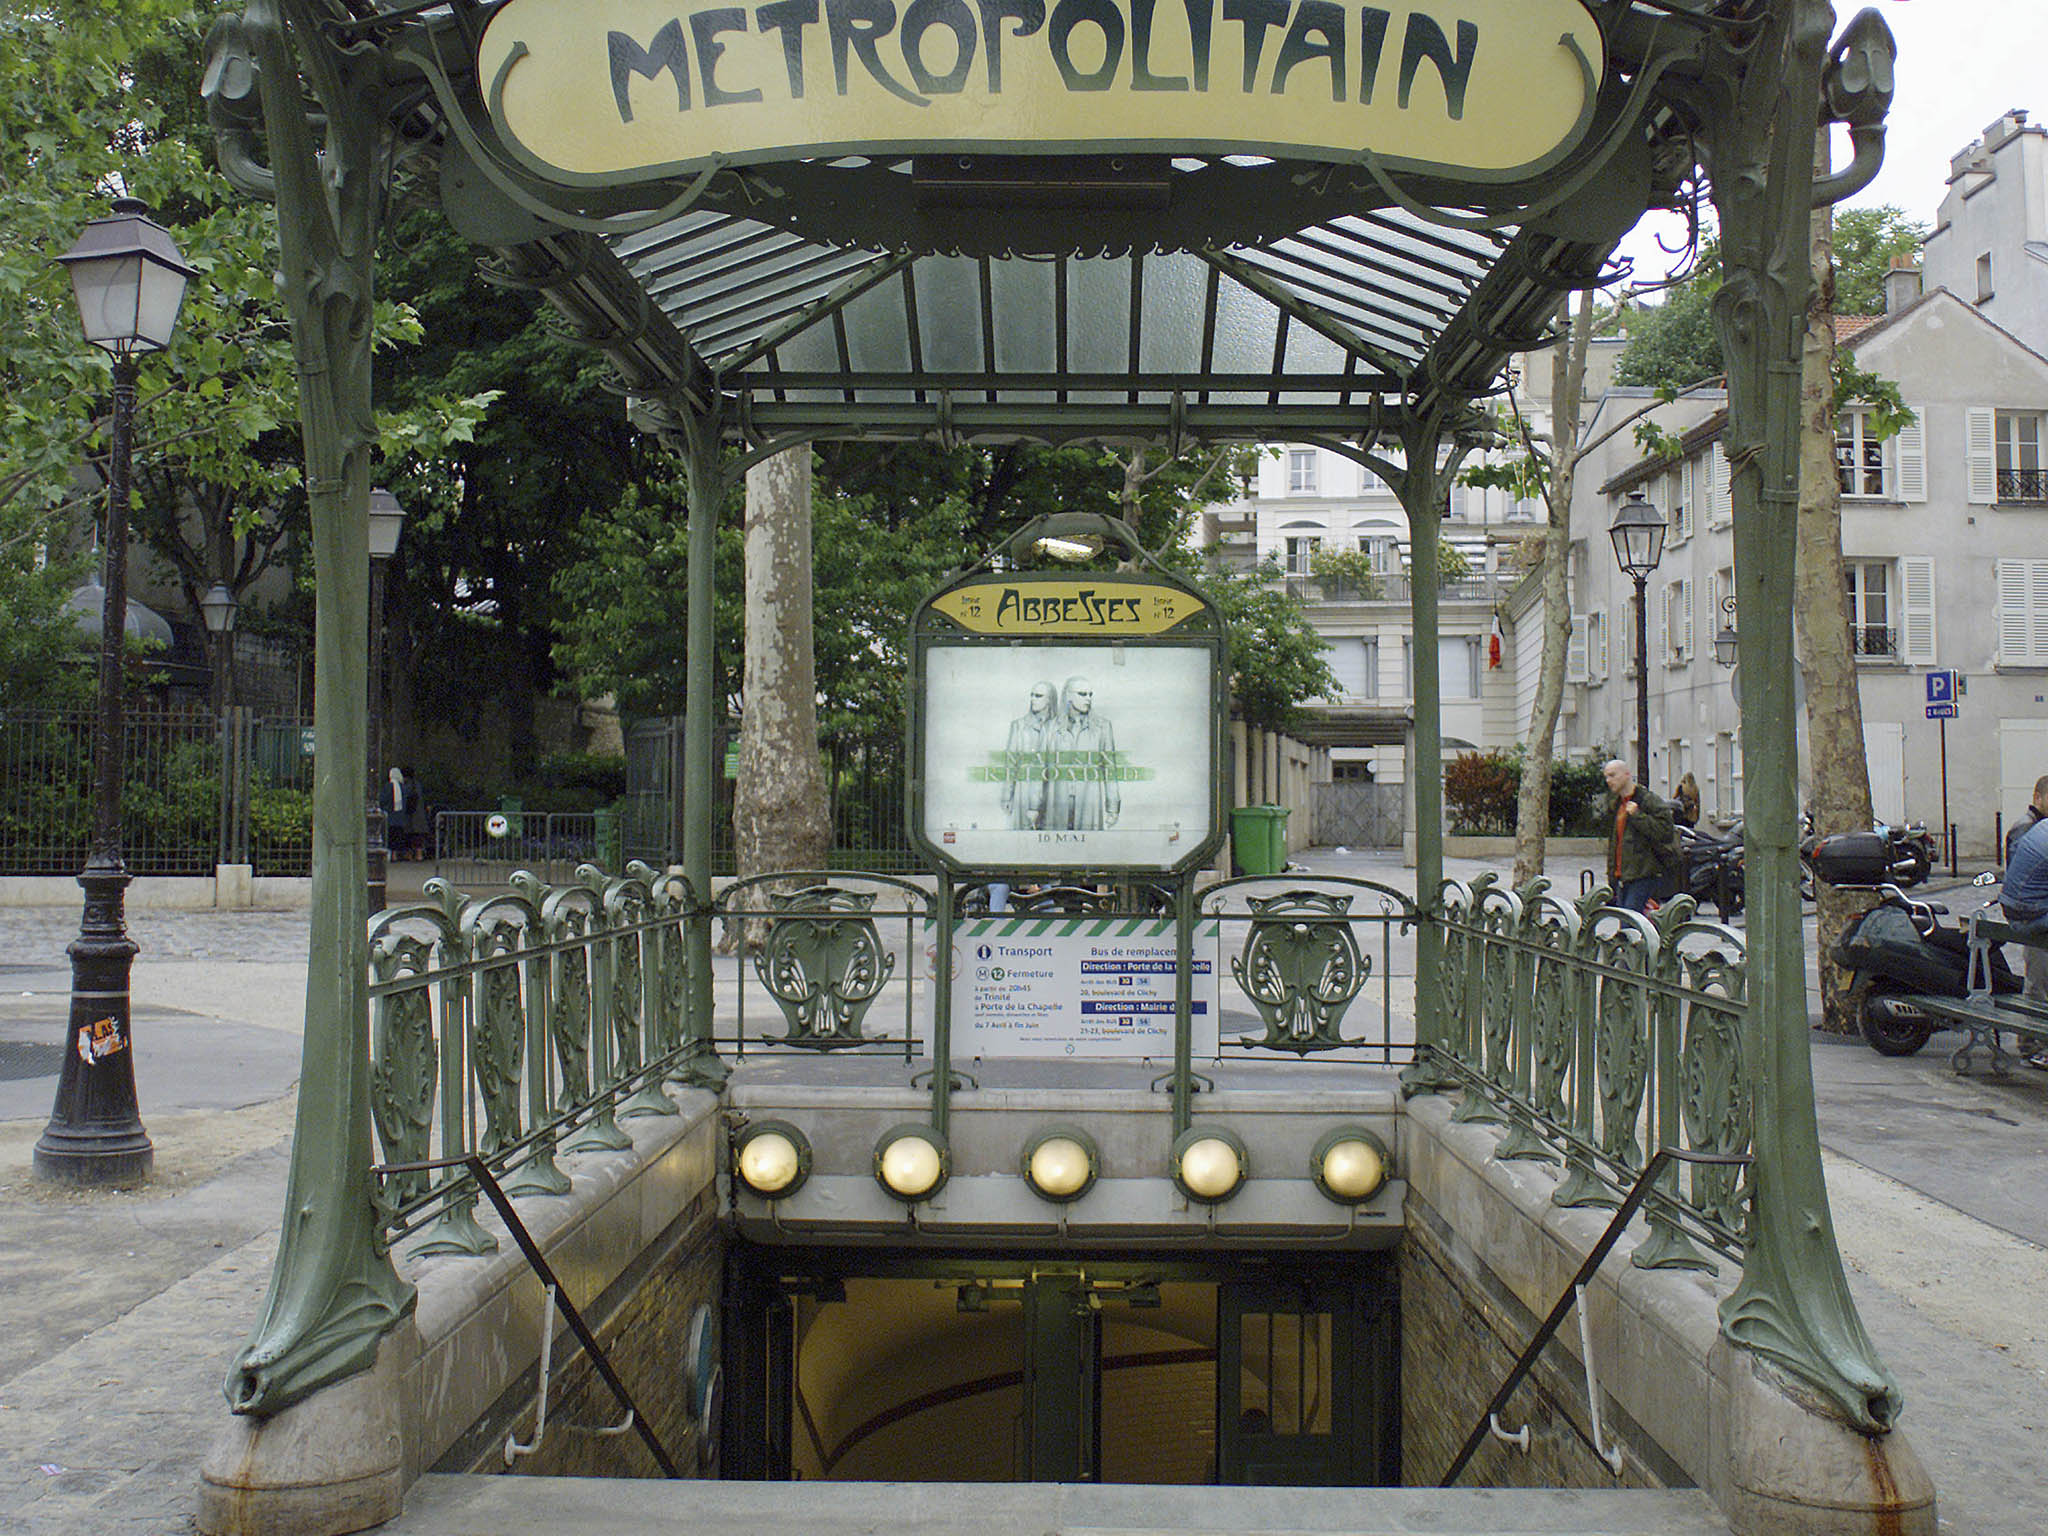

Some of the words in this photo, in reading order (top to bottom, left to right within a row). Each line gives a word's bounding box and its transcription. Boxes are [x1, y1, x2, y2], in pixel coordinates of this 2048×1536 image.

[606, 0, 1479, 123] METROPOLITAIN
[969, 605, 981, 617] 12
[996, 588, 1141, 627] ABBESSES
[1163, 607, 1175, 619] 12
[1931, 676, 1945, 697] P
[984, 766, 1139, 782] RELOADED
[998, 946, 1053, 958] Transport
[1091, 946, 1108, 956] Bus
[1111, 946, 1123, 956] de
[1082, 960, 1121, 971] Direction
[1127, 961, 1151, 971] Porte
[1152, 961, 1162, 971] de
[1164, 961, 1173, 971] la
[992, 968, 1004, 980] 12
[1007, 969, 1054, 978] Fermeture
[1092, 989, 1125, 997] boulevard
[1126, 989, 1135, 997] de
[1136, 989, 1157, 998] Clichy
[980, 1003, 1003, 1011] Porte
[1005, 1003, 1016, 1011] de
[1017, 1003, 1025, 1011] la
[1027, 1002, 1063, 1012] Chapelle
[1095, 1002, 1135, 1011] Direction
[1140, 1002, 1168, 1011] Mairie
[1102, 1027, 1135, 1035] boulevard
[1136, 1027, 1146, 1035] de
[1147, 1027, 1168, 1036] Clichy
